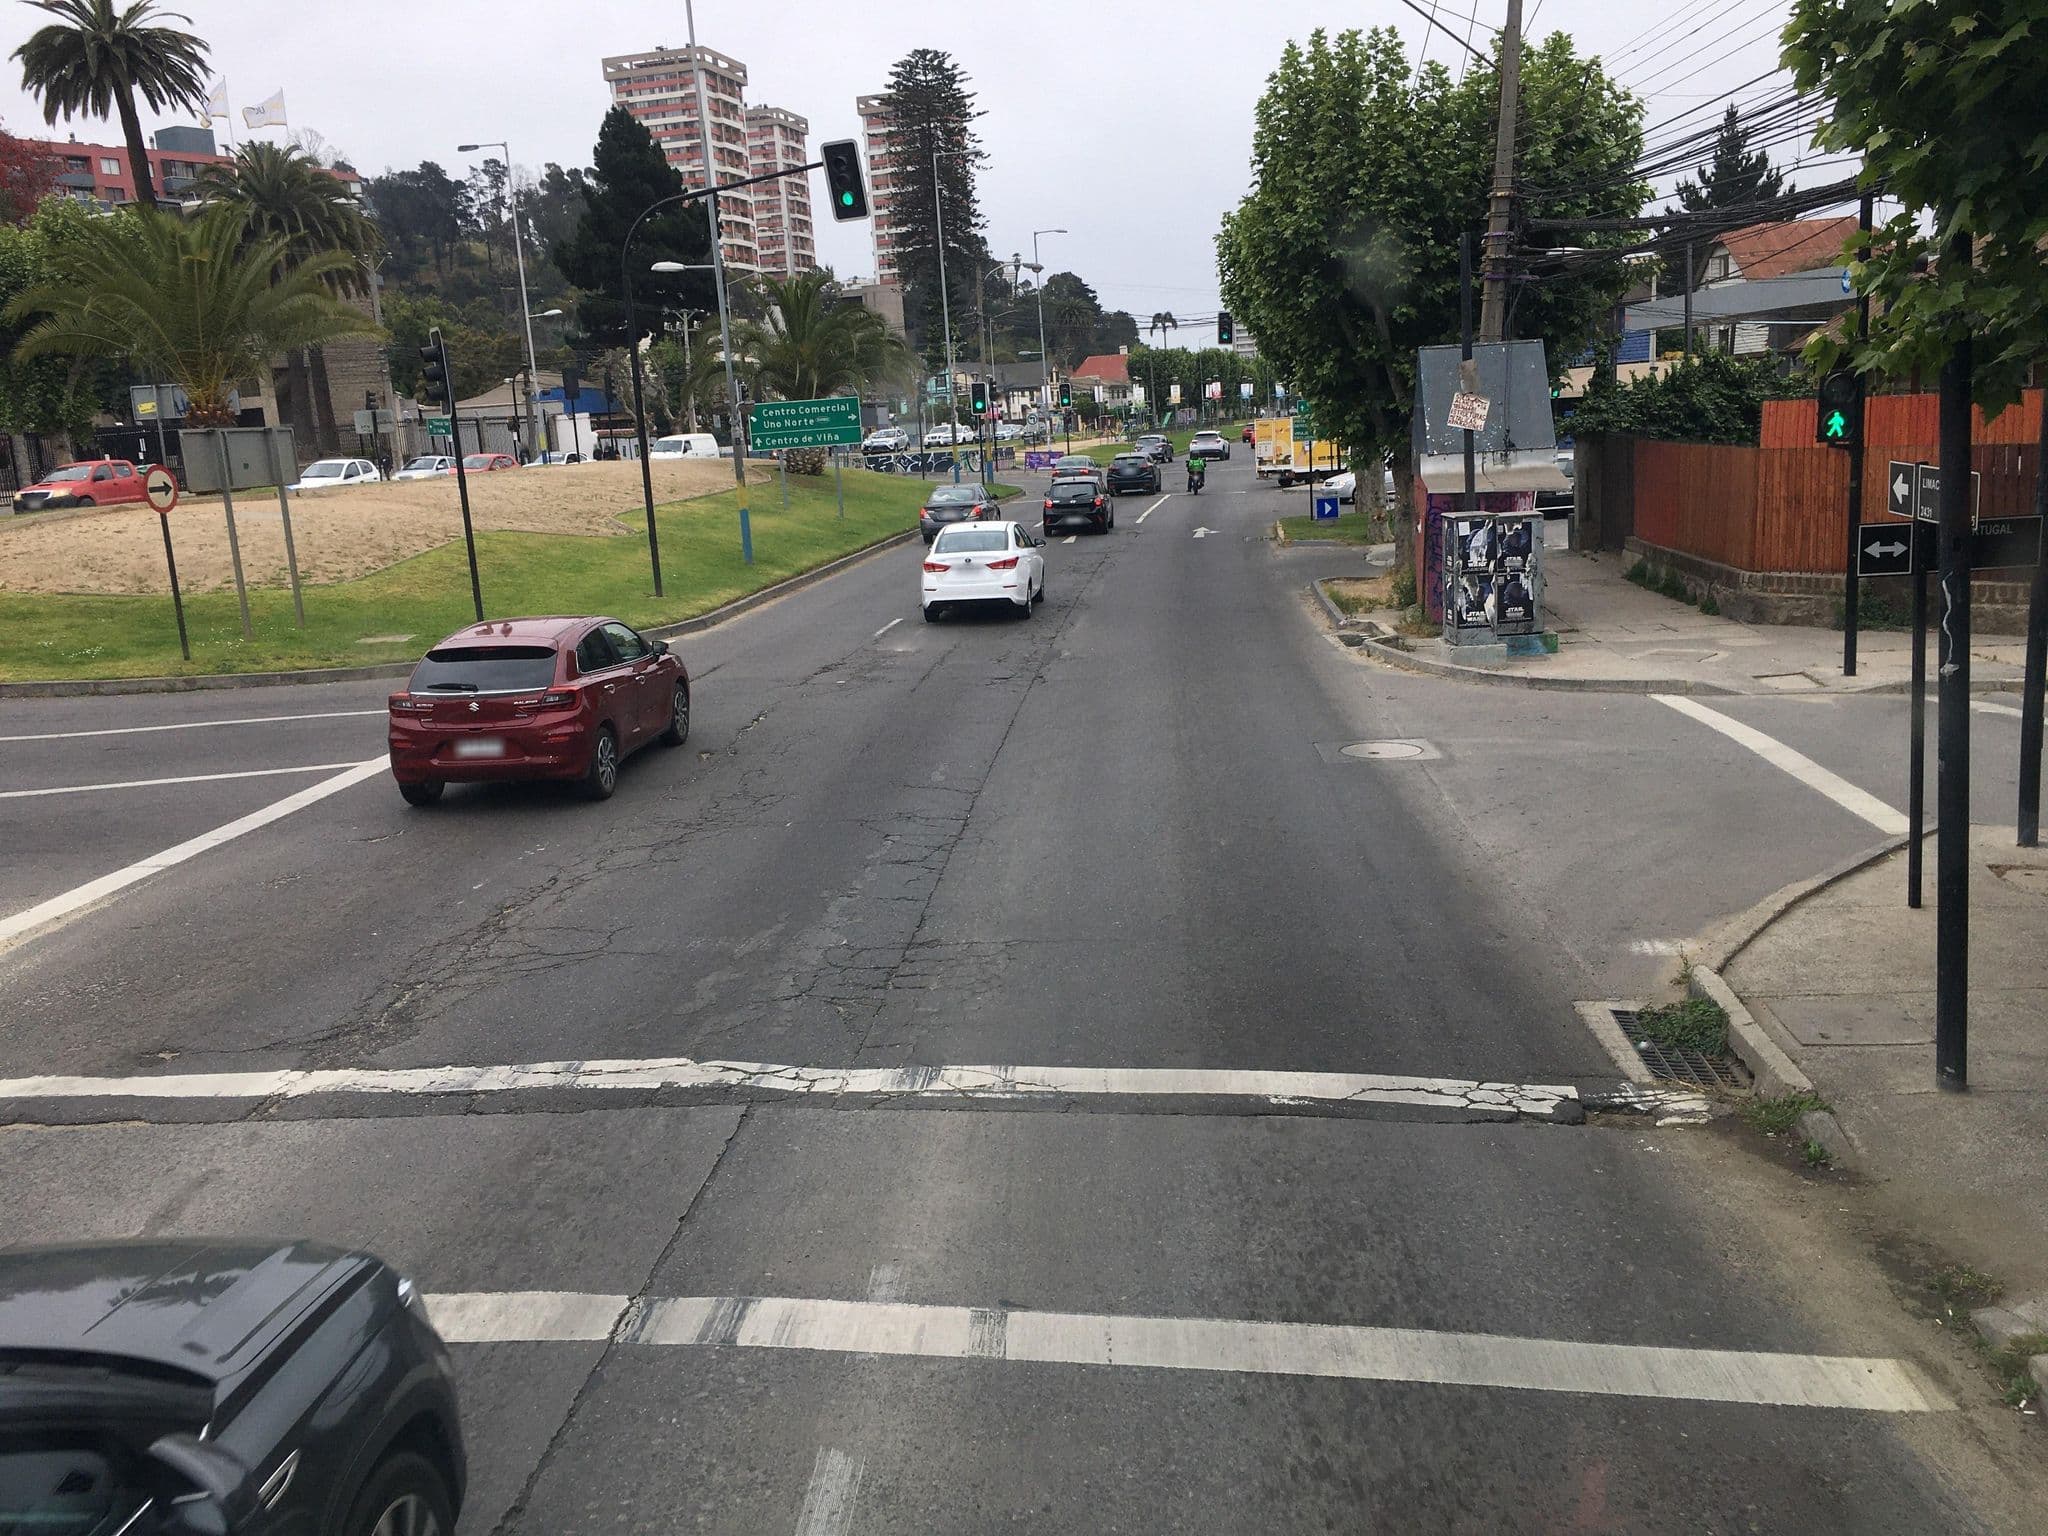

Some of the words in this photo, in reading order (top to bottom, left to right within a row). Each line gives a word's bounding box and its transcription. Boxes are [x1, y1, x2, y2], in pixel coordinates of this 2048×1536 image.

[762, 407, 796, 417] Centro
[798, 403, 850, 415] Comercial
[763, 420, 782, 429] Uno
[784, 417, 815, 427] Norte
[765, 436, 800, 446] Centro
[801, 434, 813, 443] de
[816, 432, 840, 442] Viña
[1922, 478, 1941, 490] LIMAC
[1972, 523, 2013, 536] RTUGAL
